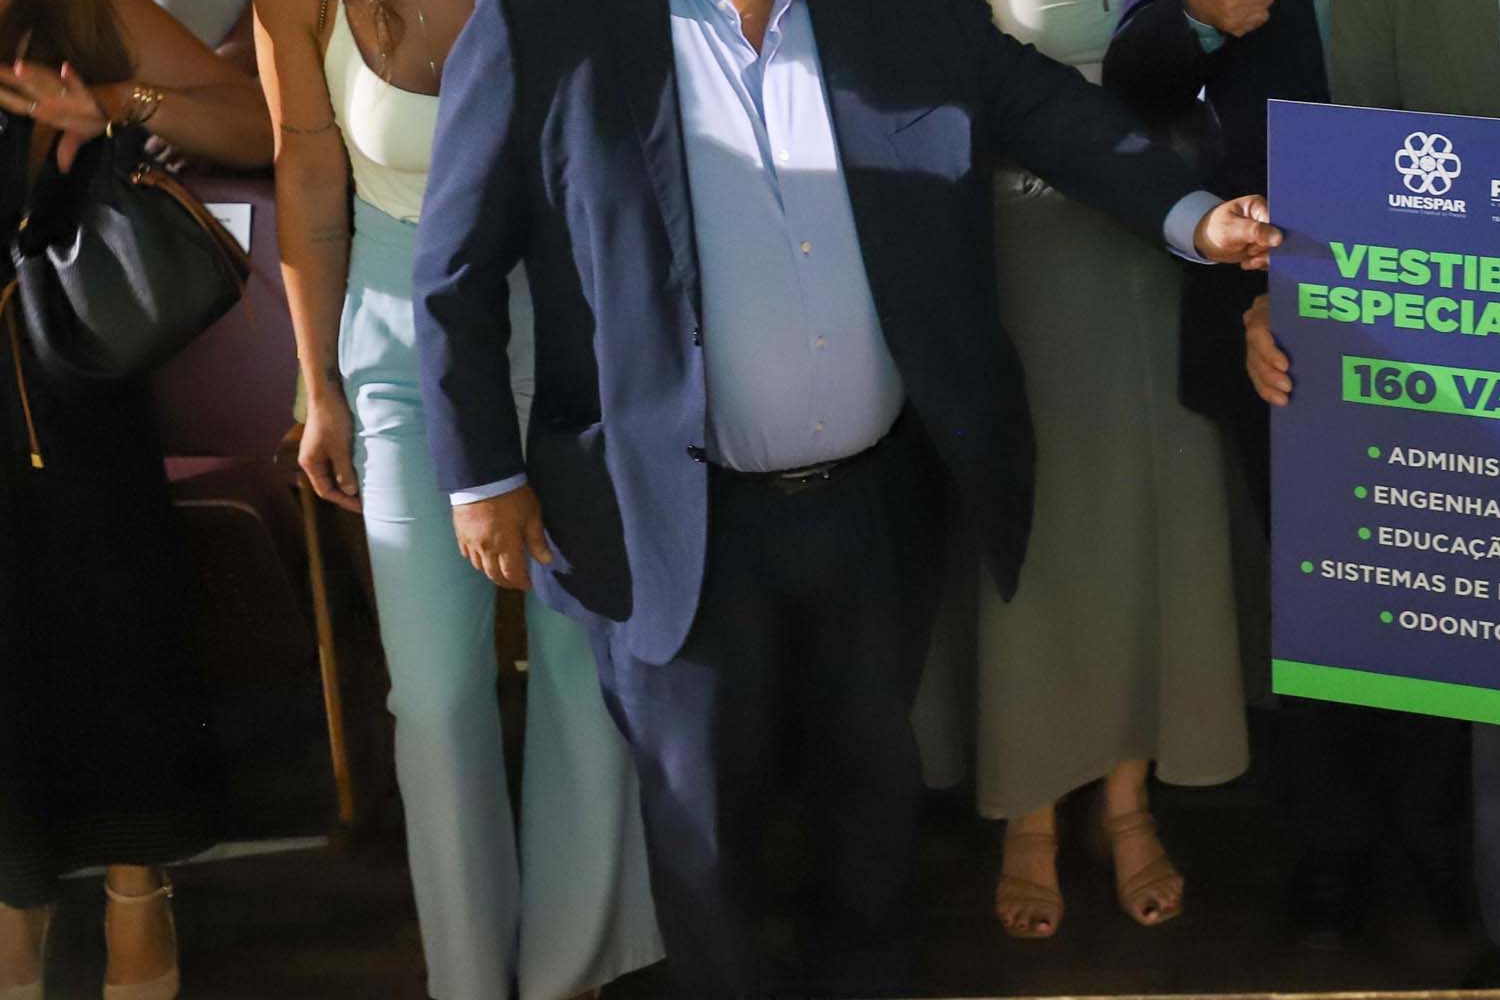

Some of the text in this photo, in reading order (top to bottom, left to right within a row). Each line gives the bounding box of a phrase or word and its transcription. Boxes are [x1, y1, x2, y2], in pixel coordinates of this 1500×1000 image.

[1389, 195, 1465, 212] UNESPAR
[1354, 365, 1436, 404] 160
[1322, 560, 1445, 592] SISTEMAS
[1456, 578, 1488, 598] DE
